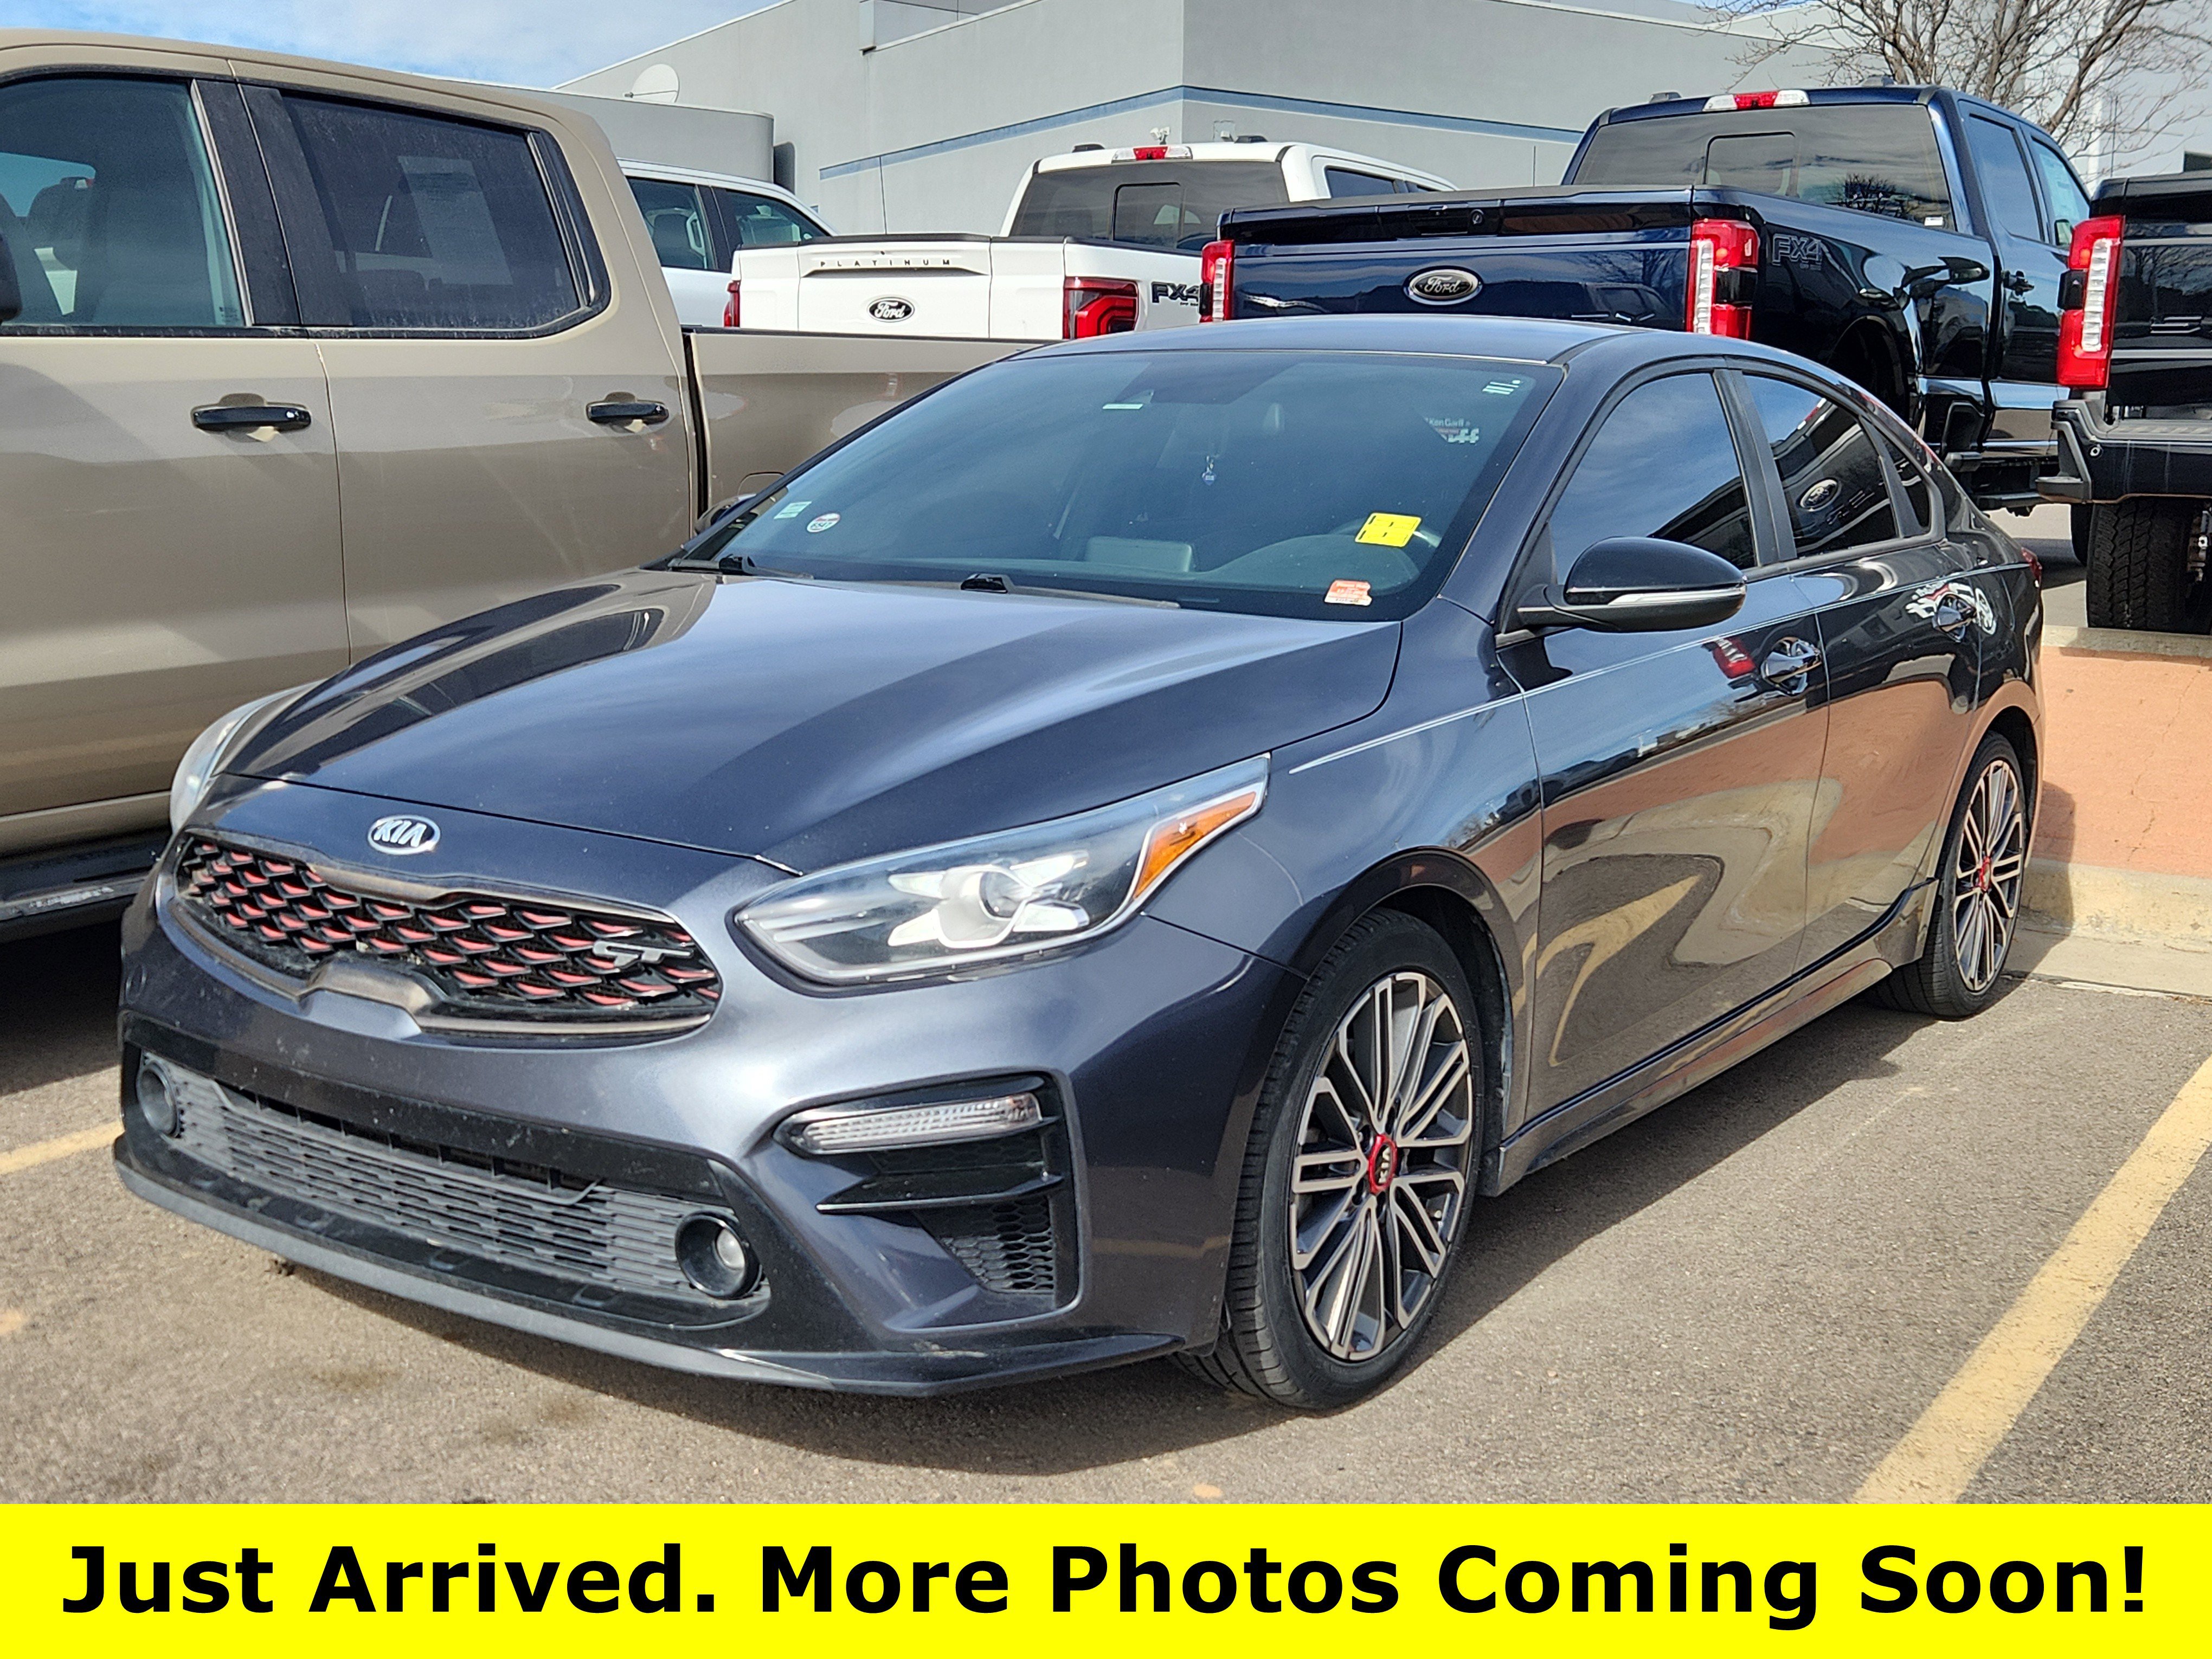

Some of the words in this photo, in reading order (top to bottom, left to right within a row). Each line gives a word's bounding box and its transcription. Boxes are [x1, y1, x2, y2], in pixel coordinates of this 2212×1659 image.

[1772, 233, 1822, 266] FX4
[820, 259, 950, 267] PLATINUM
[1150, 281, 1199, 303] FX4
[1424, 275, 1461, 293] Ford
[874, 300, 906, 319] Ford
[373, 819, 427, 847] KIA
[592, 940, 695, 967] GT
[1378, 1146, 1391, 1185] KIA
